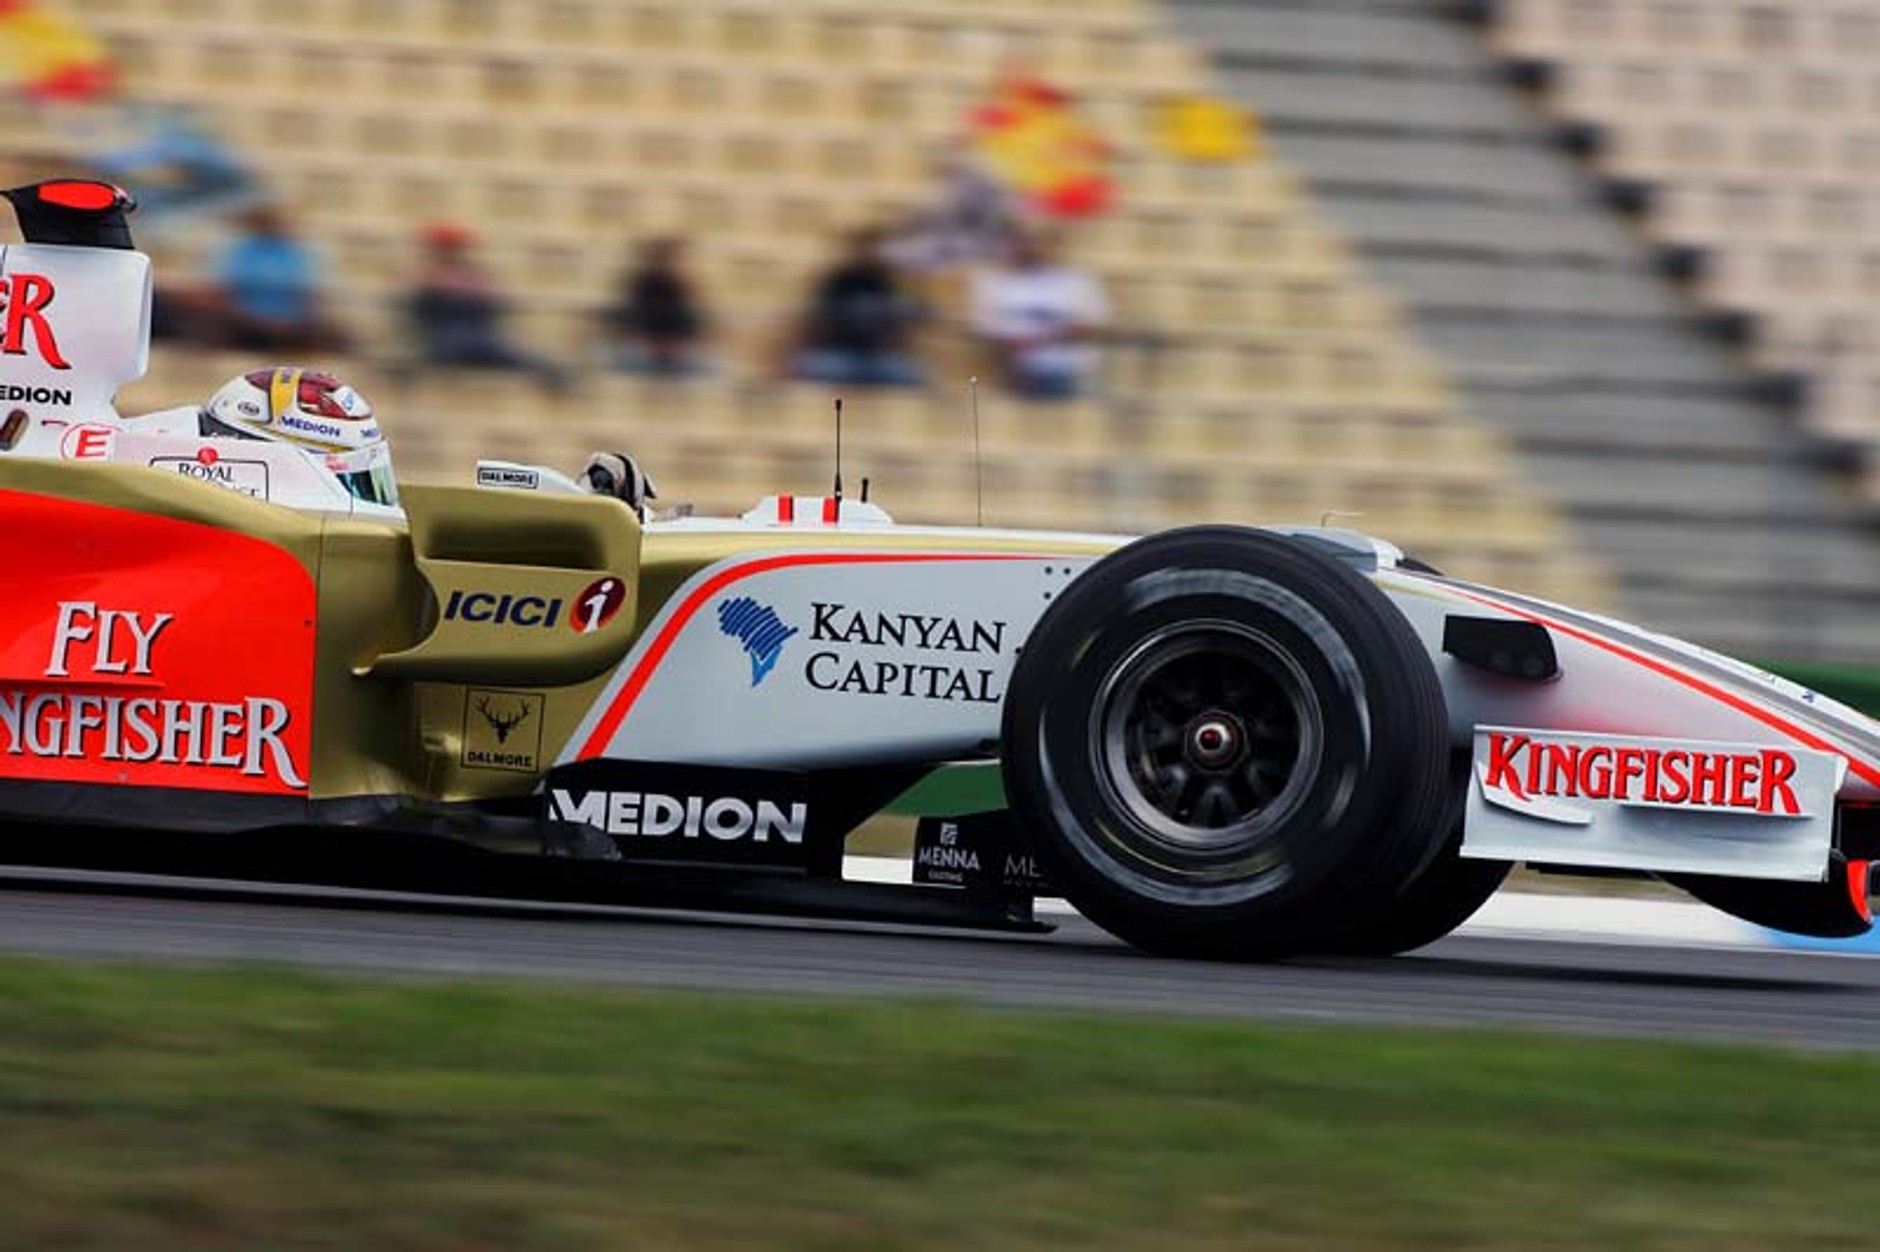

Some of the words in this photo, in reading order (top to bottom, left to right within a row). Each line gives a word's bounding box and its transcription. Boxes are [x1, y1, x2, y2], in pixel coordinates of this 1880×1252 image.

[279, 416, 341, 438] MEDION
[178, 463, 235, 483] ROYAL
[443, 590, 563, 628] ICICI
[809, 602, 1007, 654] KANYAN
[44, 601, 175, 677] FLY
[805, 651, 1001, 703] CAPITAL
[467, 751, 533, 768] DALMORE
[1486, 734, 1801, 815] KINGFISHER
[549, 789, 808, 843] MEDION
[918, 847, 981, 871] MENNA
